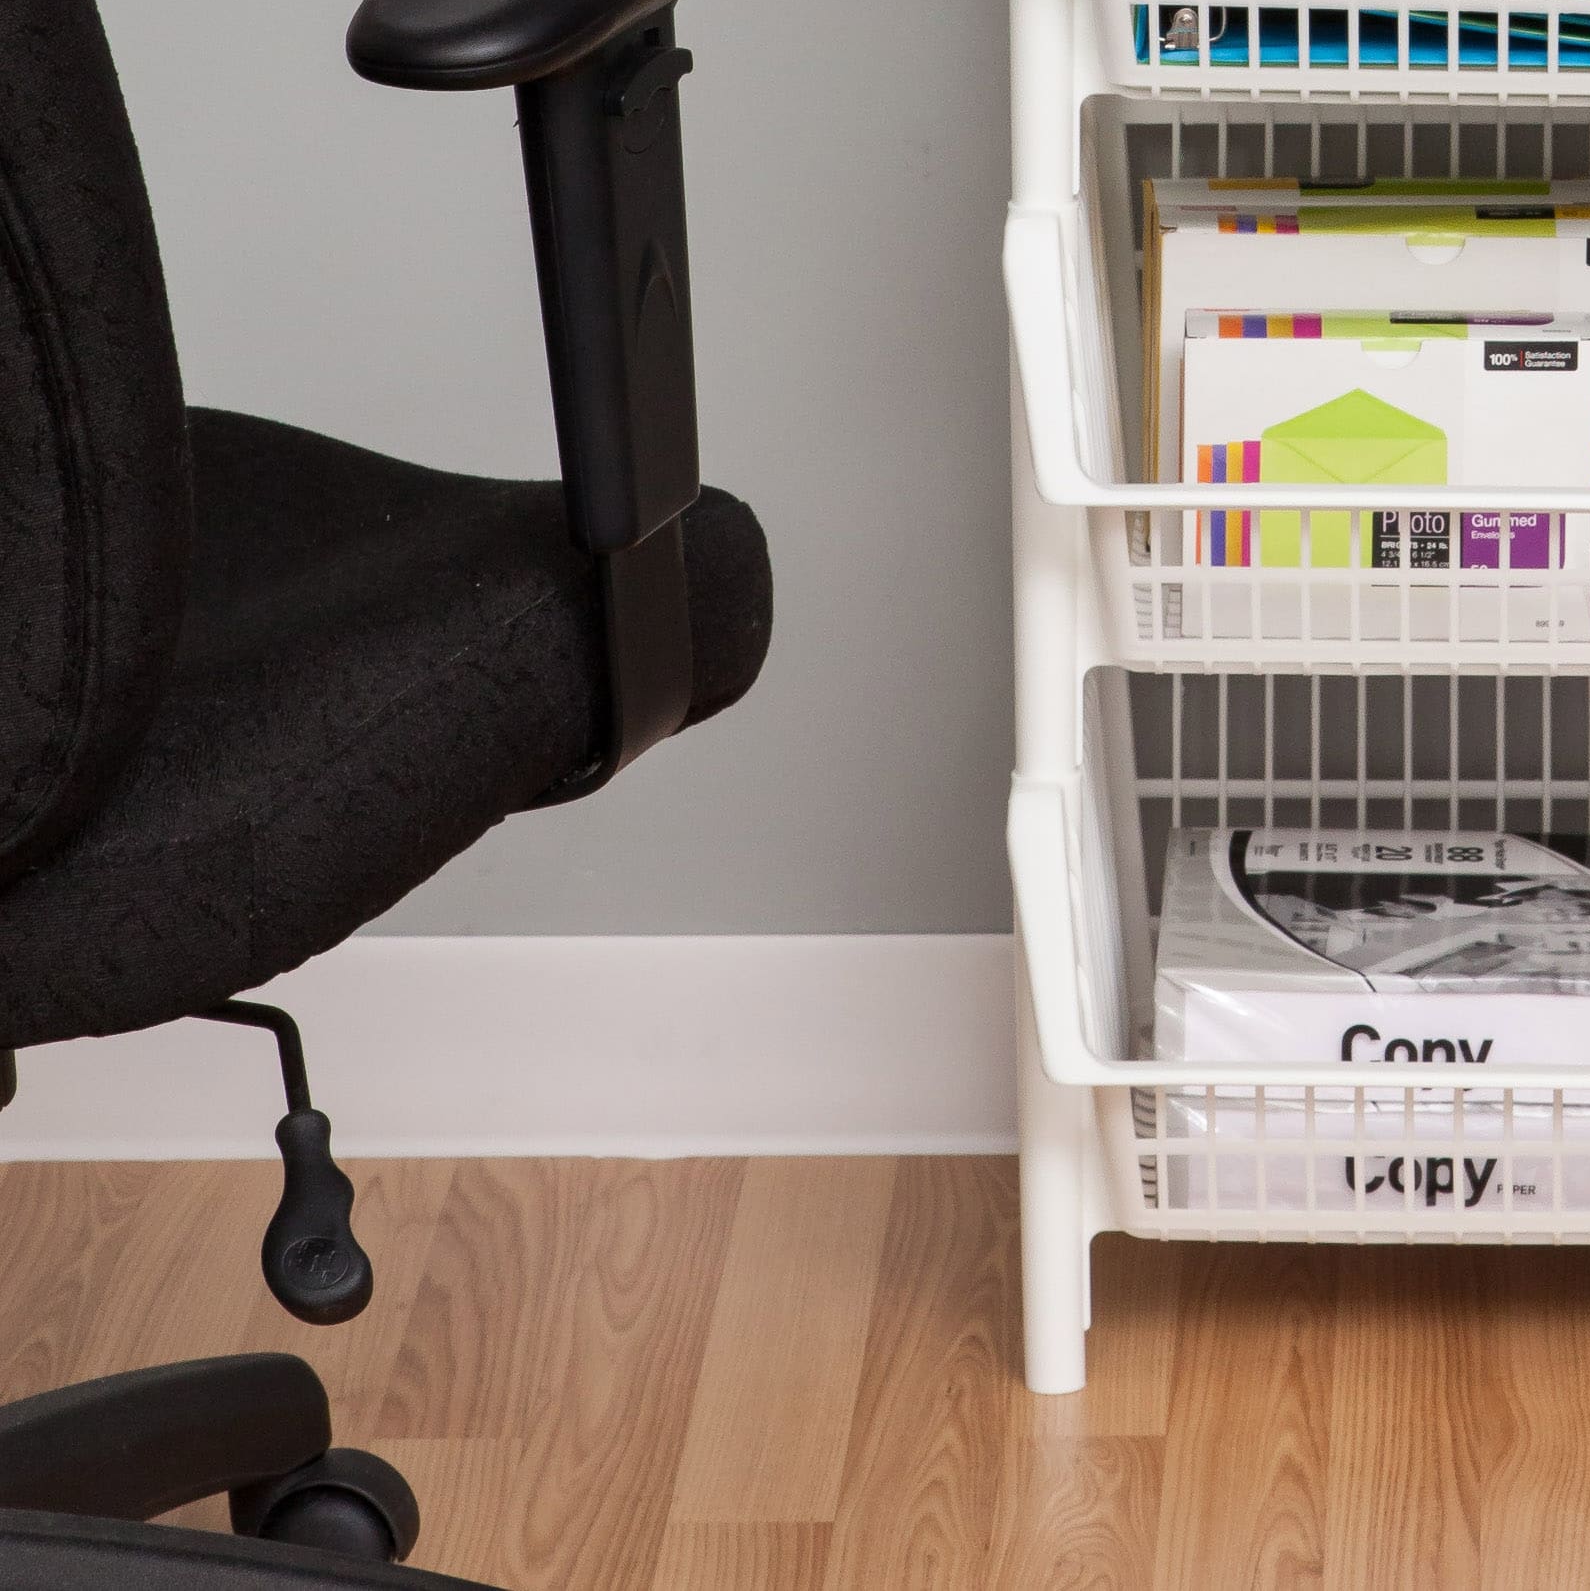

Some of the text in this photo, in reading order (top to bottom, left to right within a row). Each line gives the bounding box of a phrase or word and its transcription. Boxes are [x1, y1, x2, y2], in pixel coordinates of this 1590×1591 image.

[1489, 353, 1518, 366] 100%
[1524, 351, 1571, 360] Satisfaction
[1382, 511, 1445, 533] Poto
[1375, 845, 1413, 861] 20
[1497, 1184, 1536, 1195] PPER
